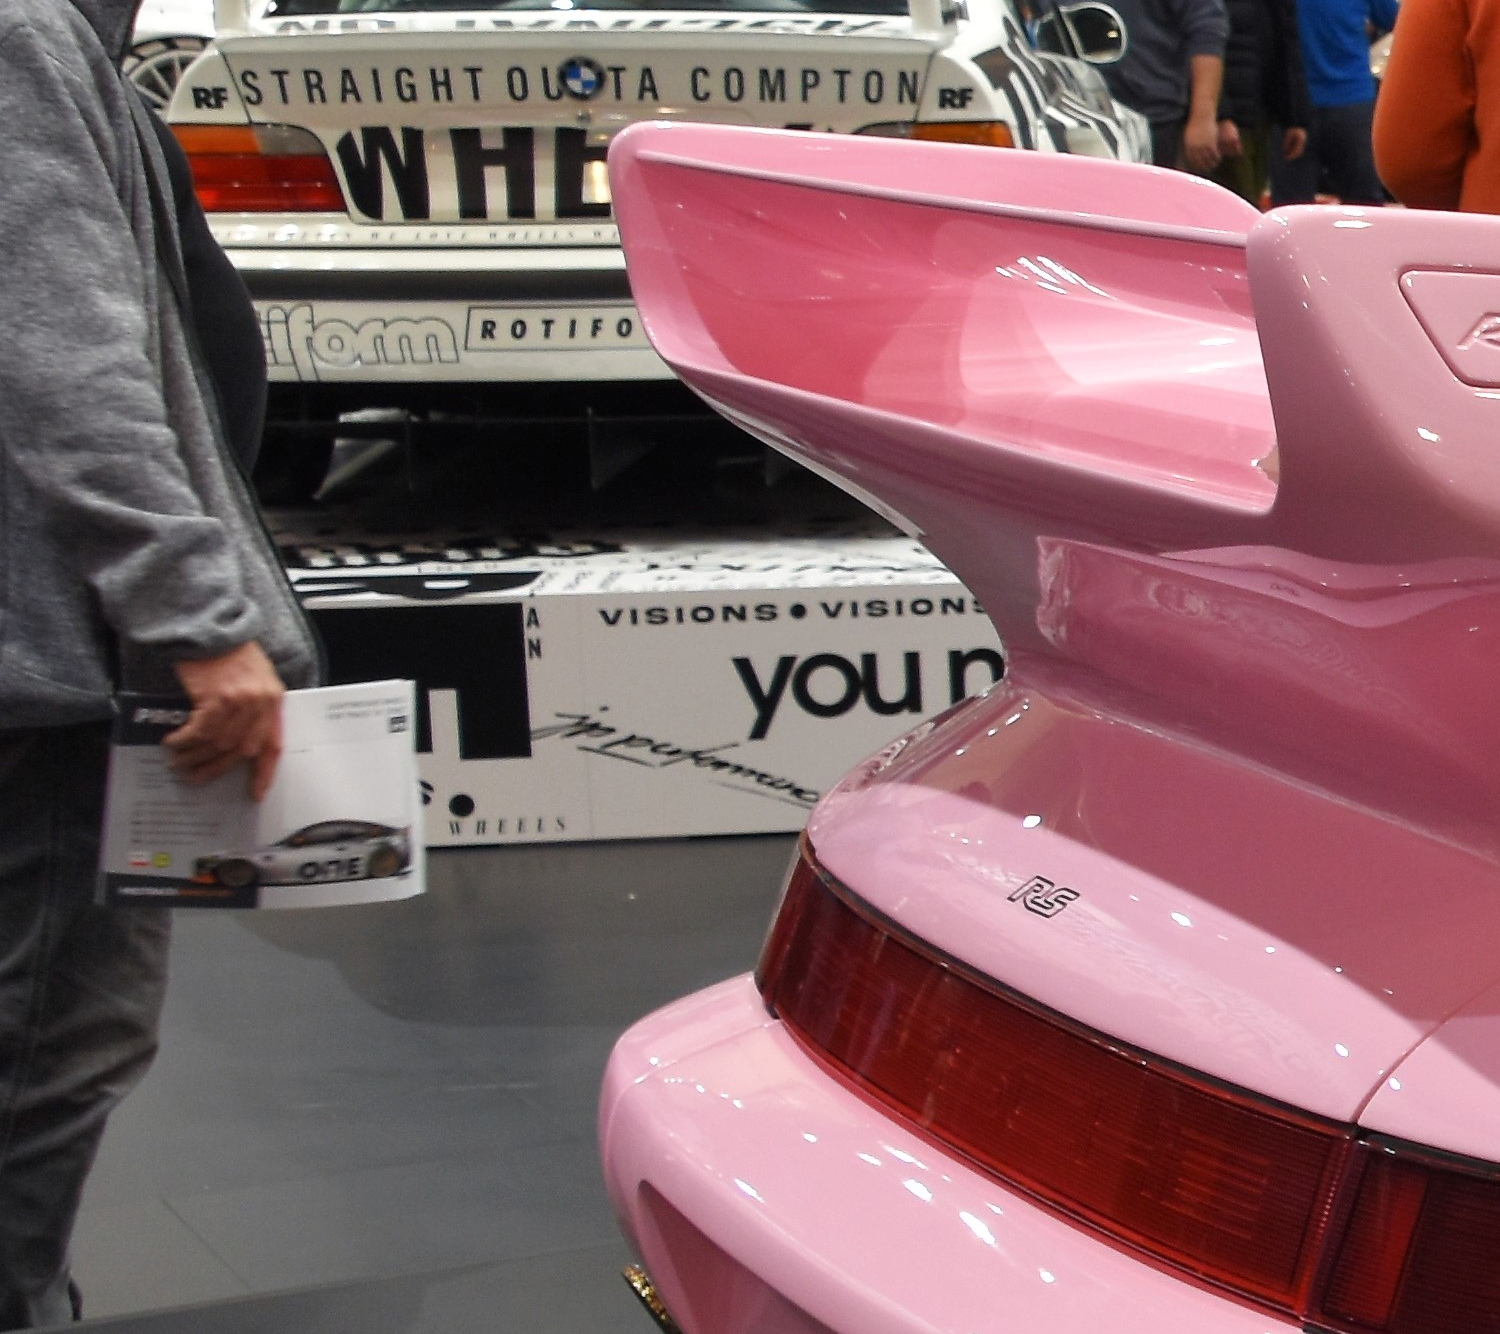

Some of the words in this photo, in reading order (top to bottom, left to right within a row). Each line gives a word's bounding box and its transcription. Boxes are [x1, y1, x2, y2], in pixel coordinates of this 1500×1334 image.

[191, 86, 229, 110] RF
[240, 67, 483, 106] STRAIGHT
[507, 66, 659, 104] OUTA
[690, 67, 919, 105] COMPTON
[938, 87, 974, 110] RF
[599, 603, 779, 627] VISIONS
[731, 648, 923, 741] you
[1006, 875, 1081, 919] RS
